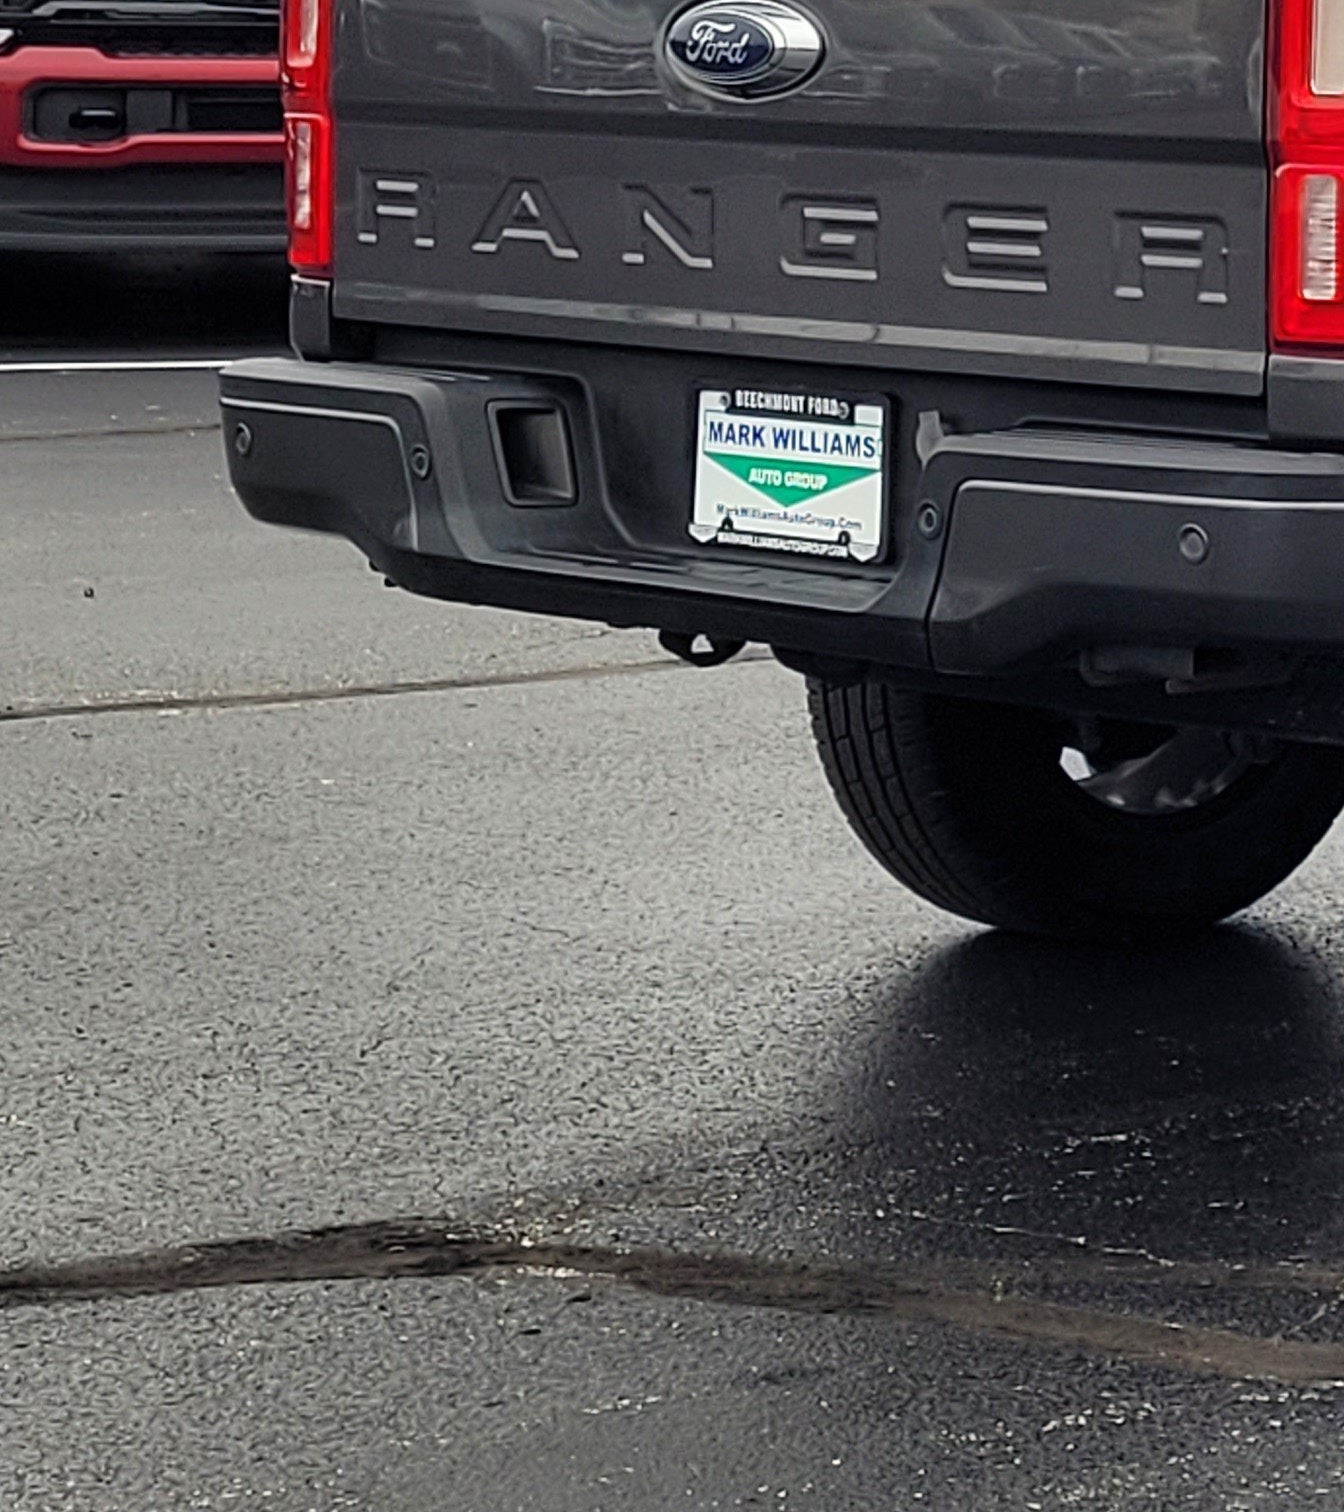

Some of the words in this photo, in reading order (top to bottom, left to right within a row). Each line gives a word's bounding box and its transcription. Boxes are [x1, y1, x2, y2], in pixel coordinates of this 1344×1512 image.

[686, 20, 750, 64] Ford
[356, 167, 1230, 305] RANGER
[735, 390, 805, 413] BEECHMONT
[807, 396, 839, 417] FORD
[708, 420, 766, 448] MARK
[772, 425, 877, 459] WILLIAMS
[748, 467, 782, 487] AUTO
[783, 470, 828, 491] GROUP
